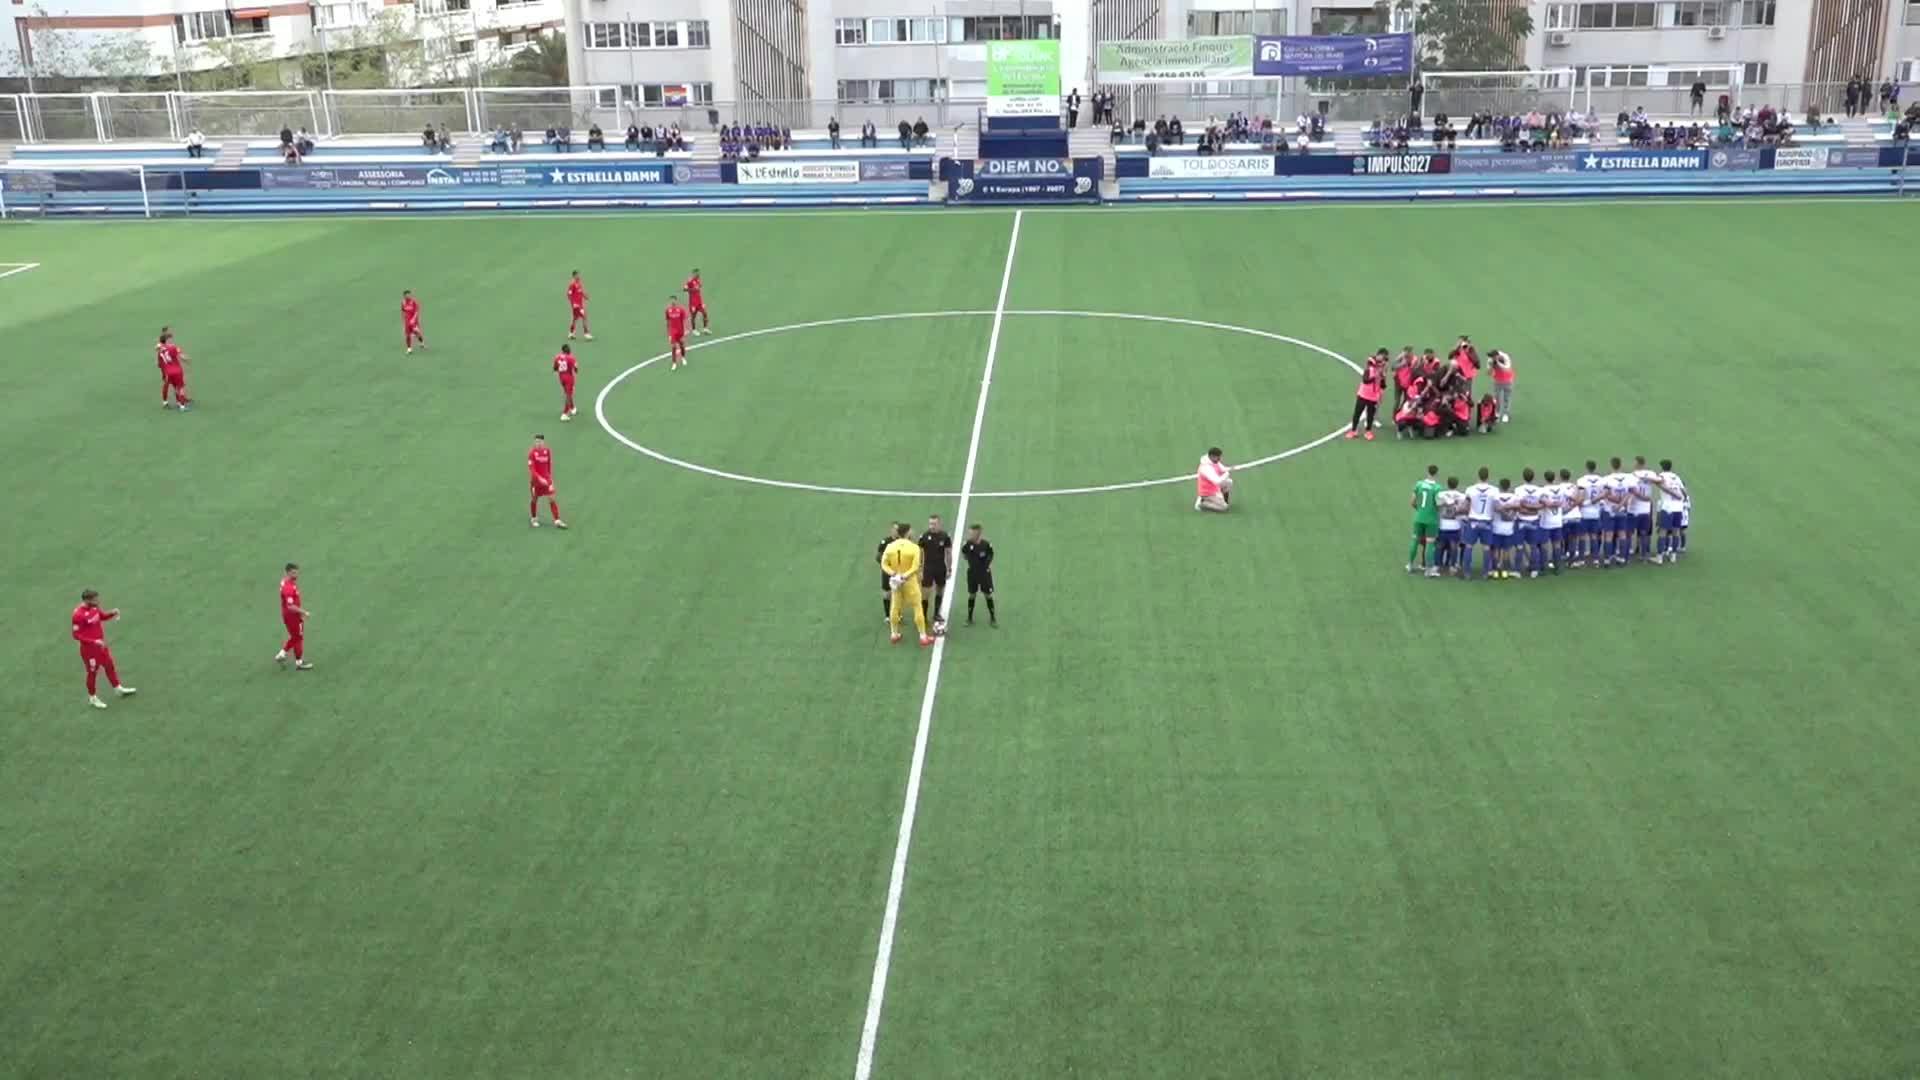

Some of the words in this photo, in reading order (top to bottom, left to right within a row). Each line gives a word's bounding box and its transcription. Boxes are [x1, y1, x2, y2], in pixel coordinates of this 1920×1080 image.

[990, 160, 1030, 173] DIEM
[1036, 160, 1059, 172] NO
[1601, 157, 1659, 168] ESTRELLA
[1661, 156, 1699, 168] DAMM
[358, 170, 404, 178] ASSESSORIA
[567, 172, 621, 182] ESTRELLA
[624, 171, 660, 182] DAMM
[1480, 499, 1487, 514] 7
